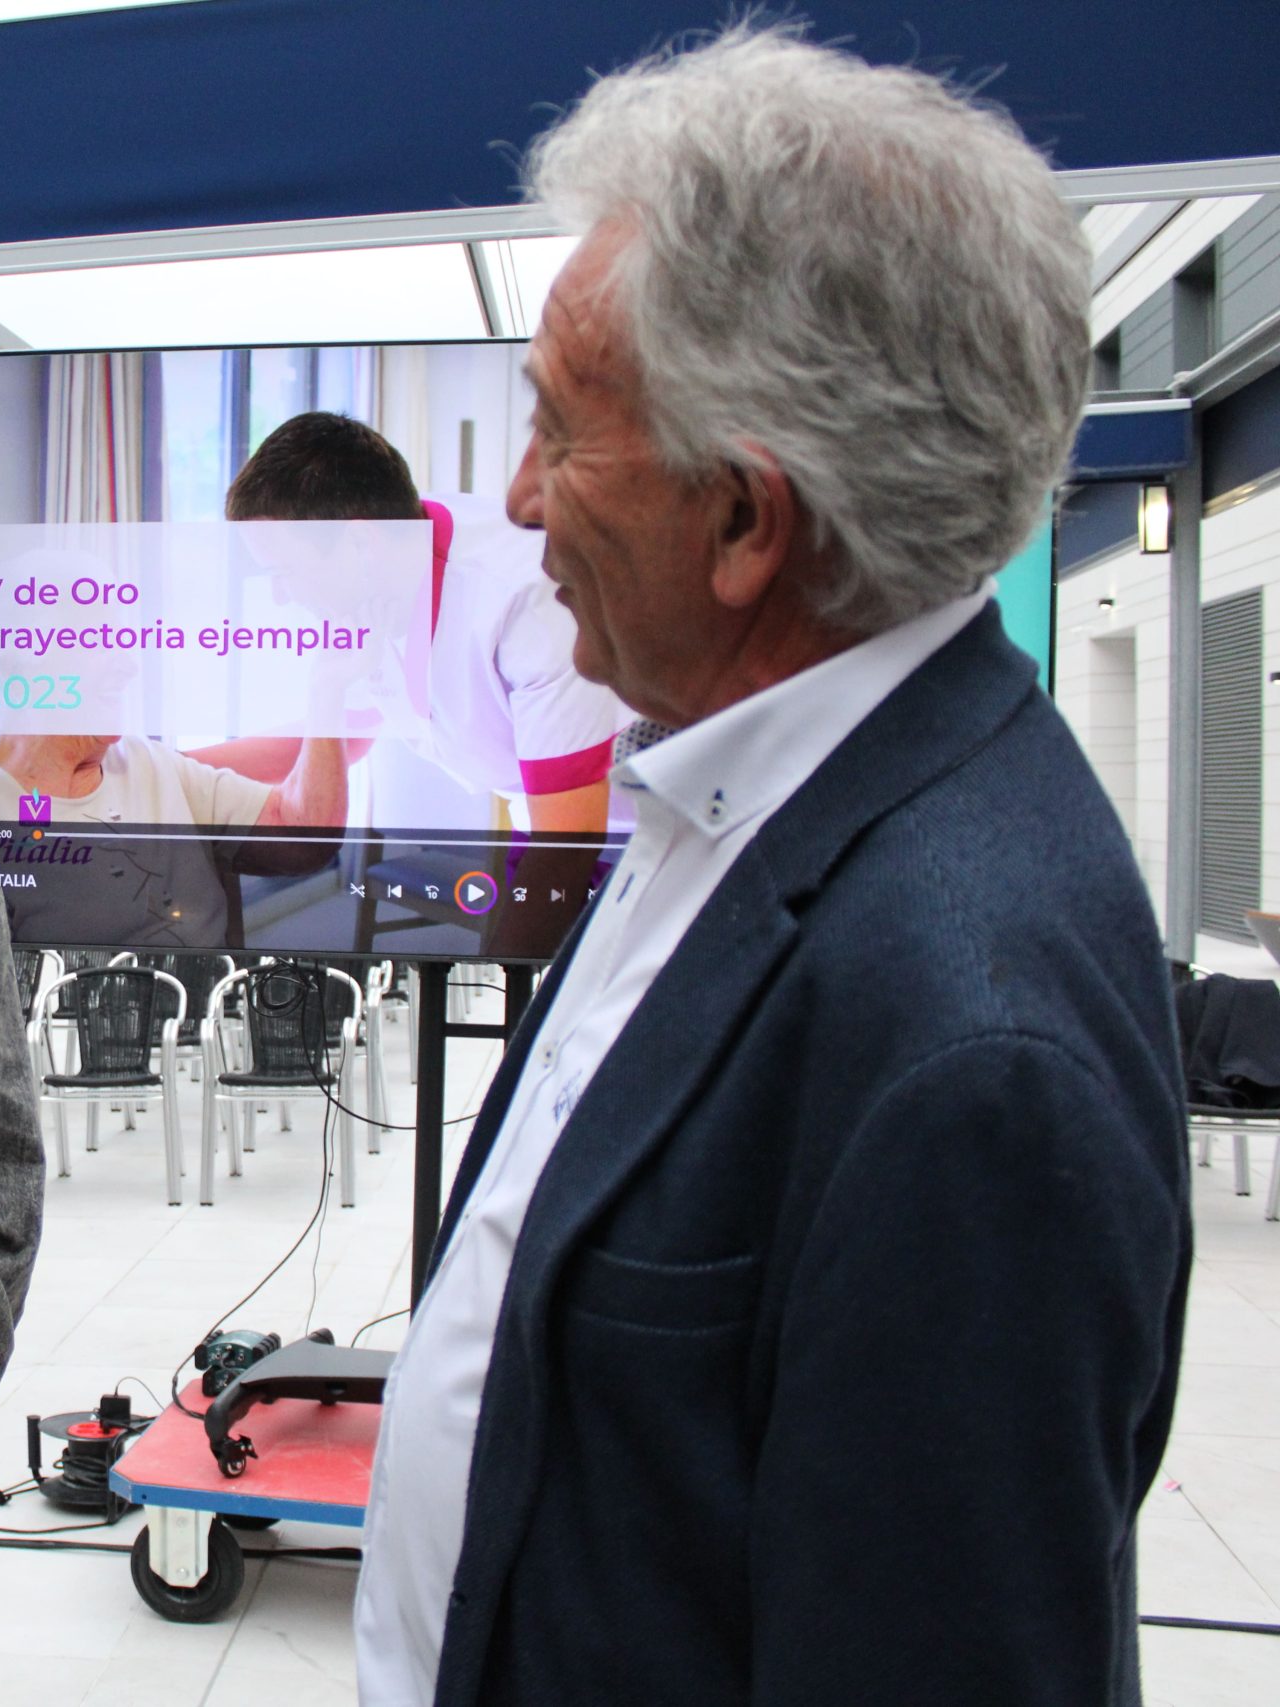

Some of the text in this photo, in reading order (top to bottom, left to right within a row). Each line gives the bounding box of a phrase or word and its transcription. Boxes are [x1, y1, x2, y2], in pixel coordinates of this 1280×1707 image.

[14, 577, 59, 605] de
[71, 578, 139, 605] Oro
[198, 620, 370, 656] ejemplar
